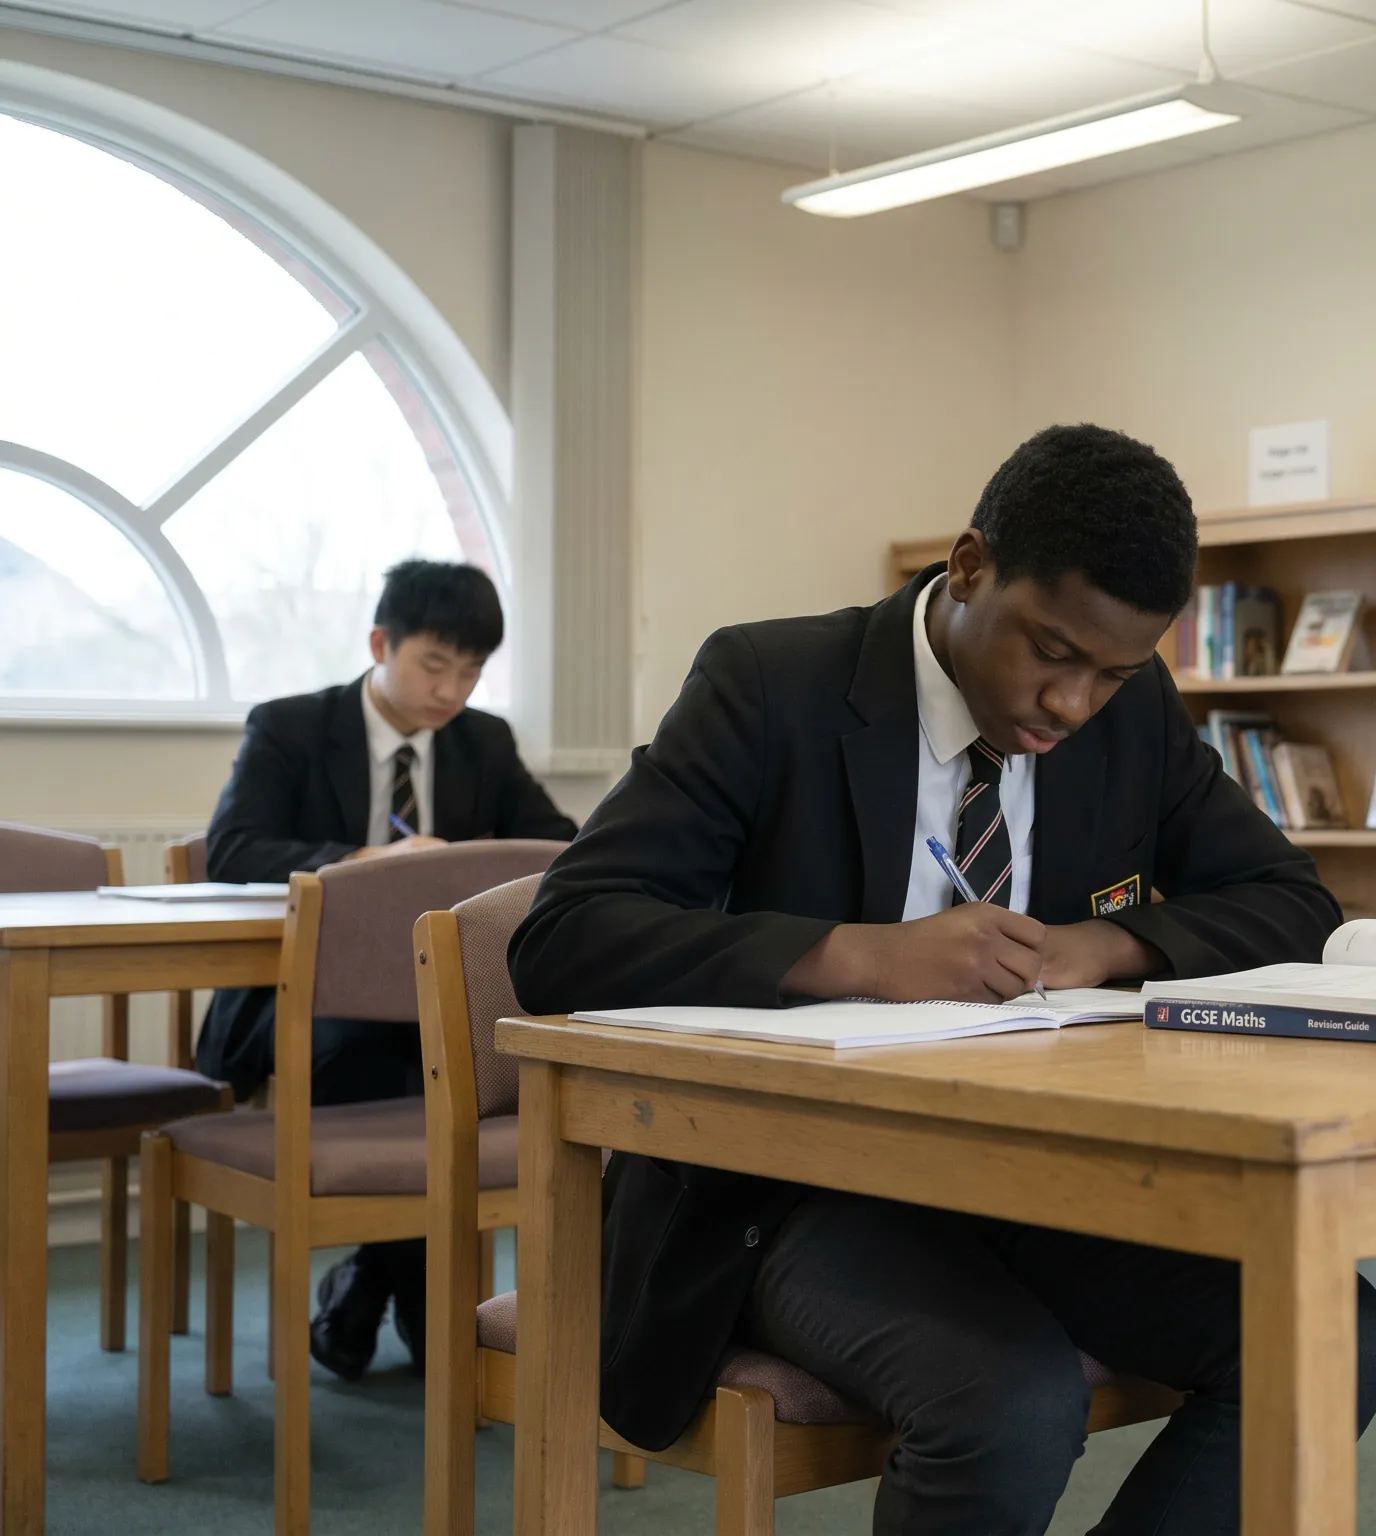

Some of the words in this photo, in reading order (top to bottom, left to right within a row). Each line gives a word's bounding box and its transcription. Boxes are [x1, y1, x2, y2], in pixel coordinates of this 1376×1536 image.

[1180, 1008, 1218, 1025] GCSE
[1221, 1010, 1266, 1029] Maths
[1307, 1018, 1343, 1030] Revision
[1344, 1020, 1370, 1032] Guide
